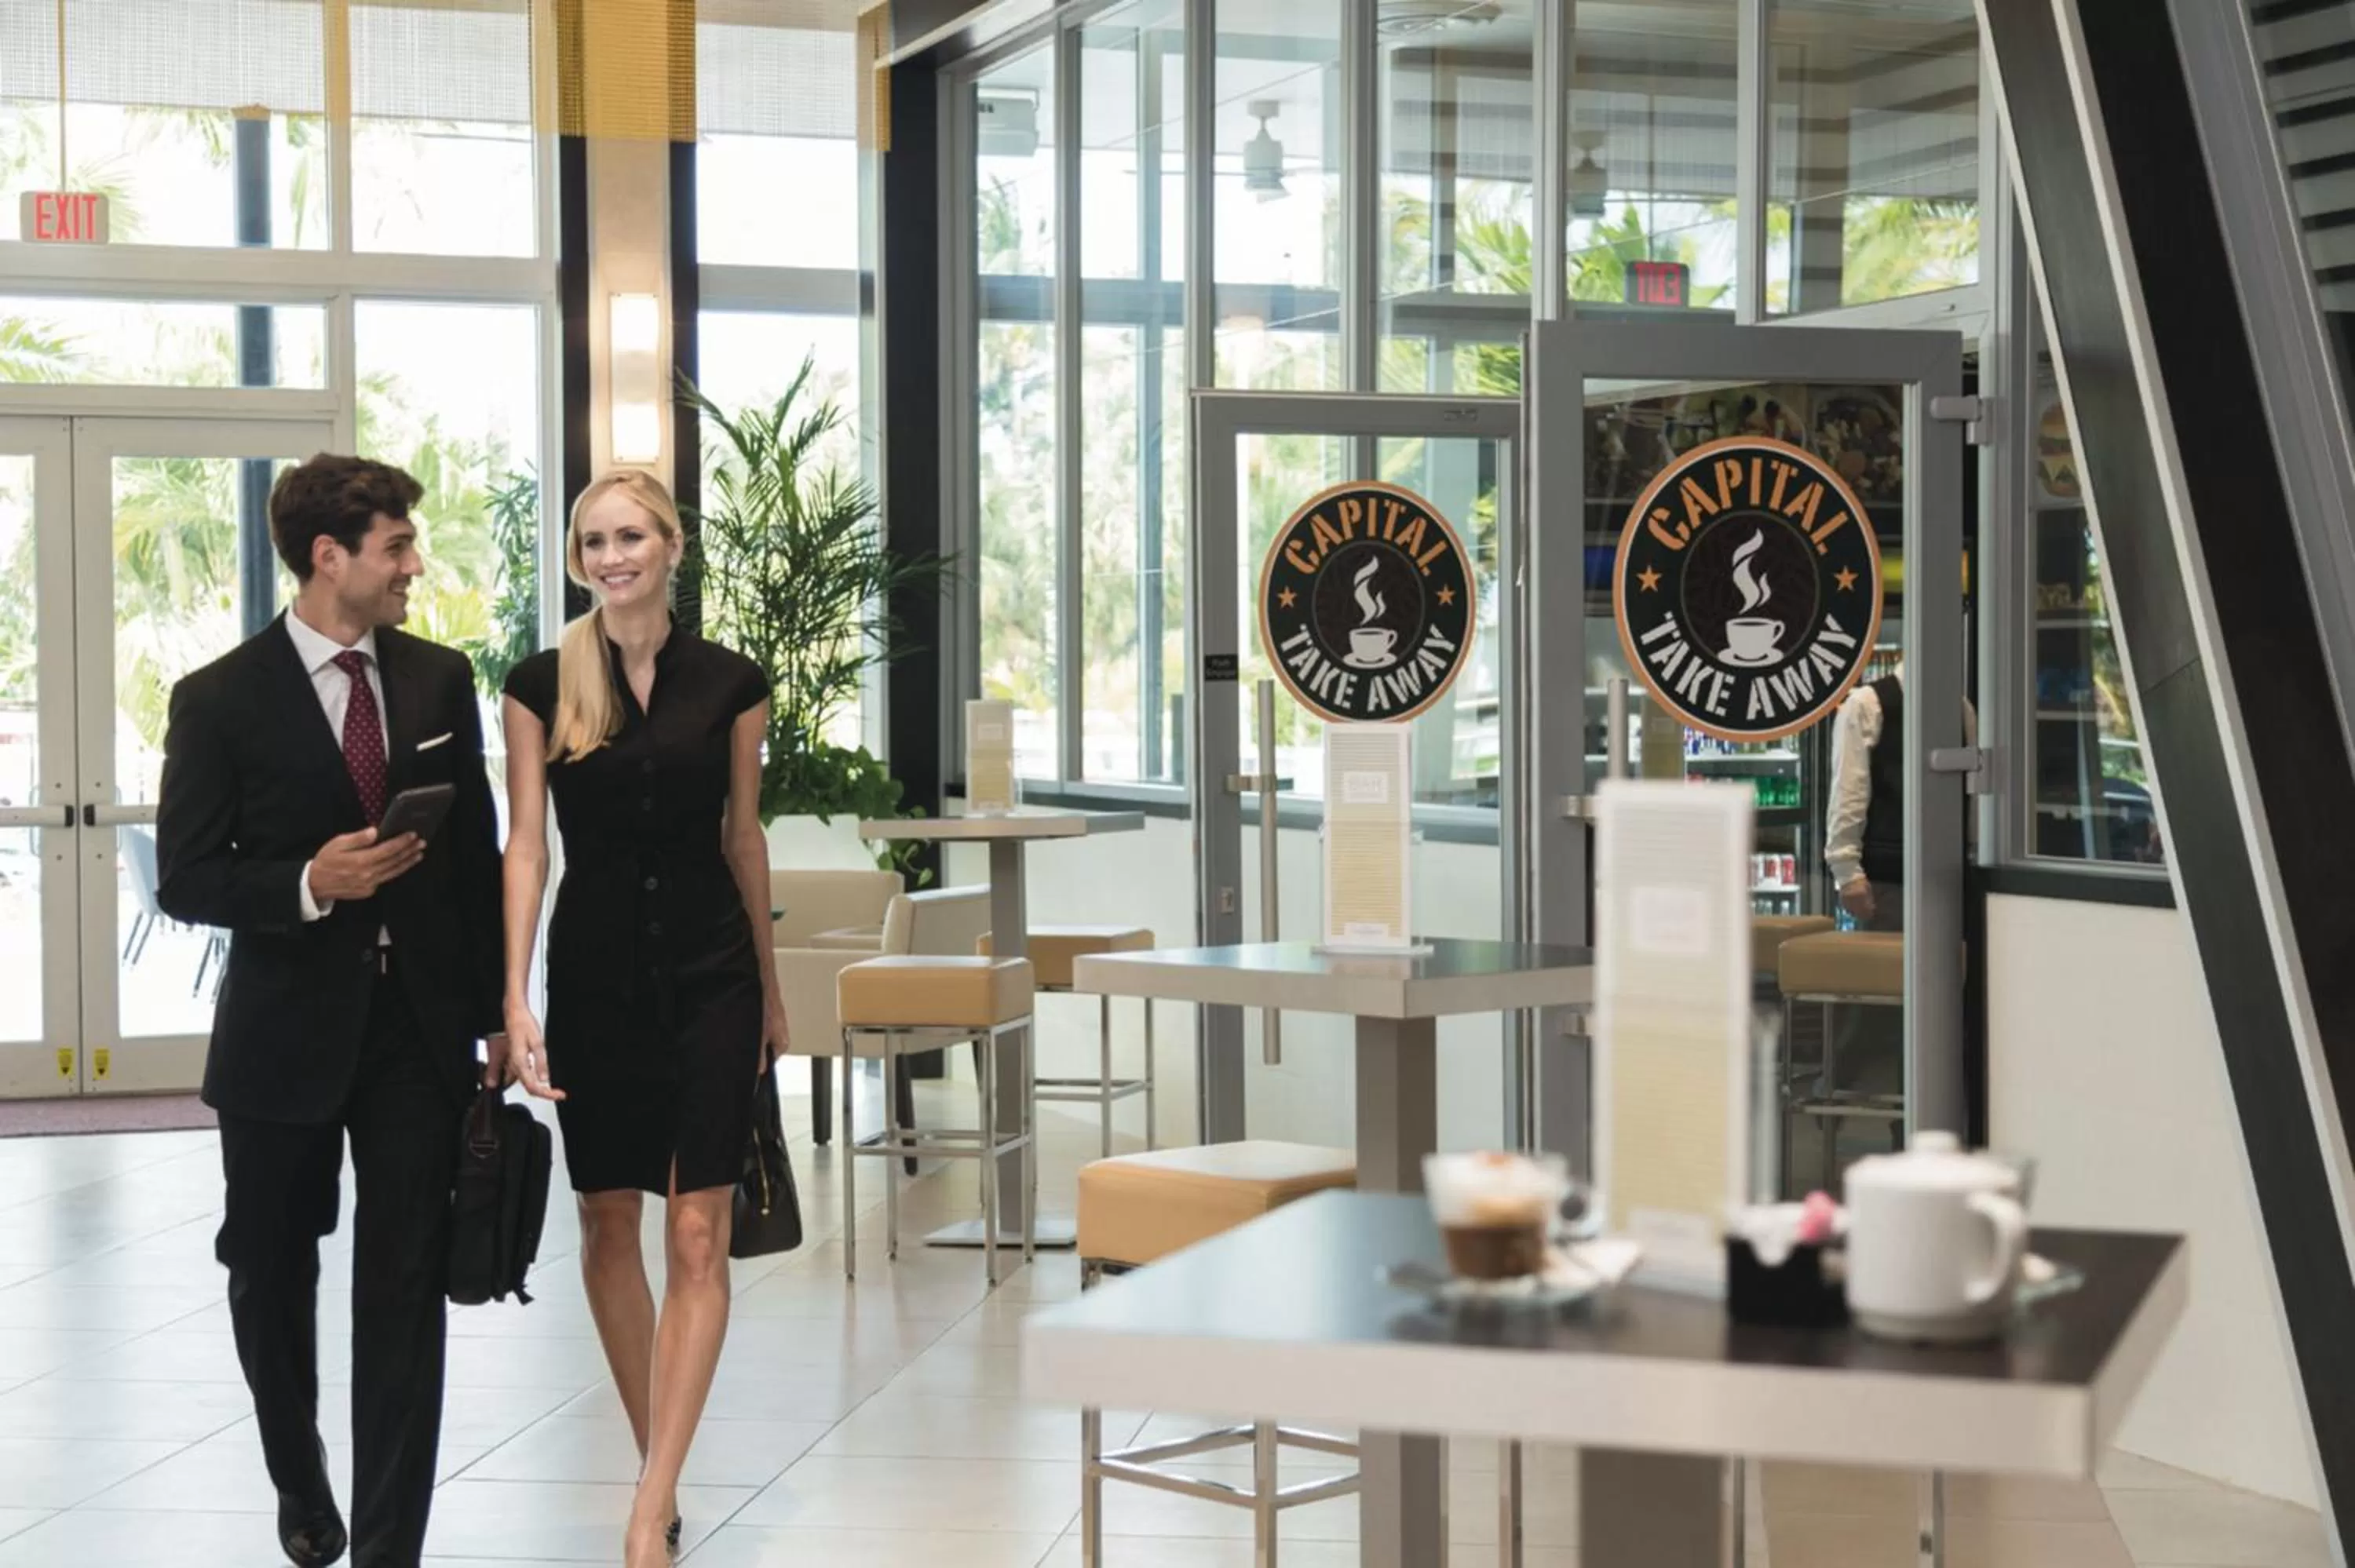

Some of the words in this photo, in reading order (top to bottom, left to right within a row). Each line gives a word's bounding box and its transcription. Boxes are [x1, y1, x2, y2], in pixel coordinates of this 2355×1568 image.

[35, 193, 98, 239] EXIT
[1284, 498, 1448, 576] CAPITAL
[1648, 457, 1849, 556] CAPITAL
[1280, 624, 1358, 711] TAKE
[1367, 625, 1455, 712] AWAY
[1640, 611, 1736, 717] TAKE
[1747, 613, 1857, 720] AWAY
